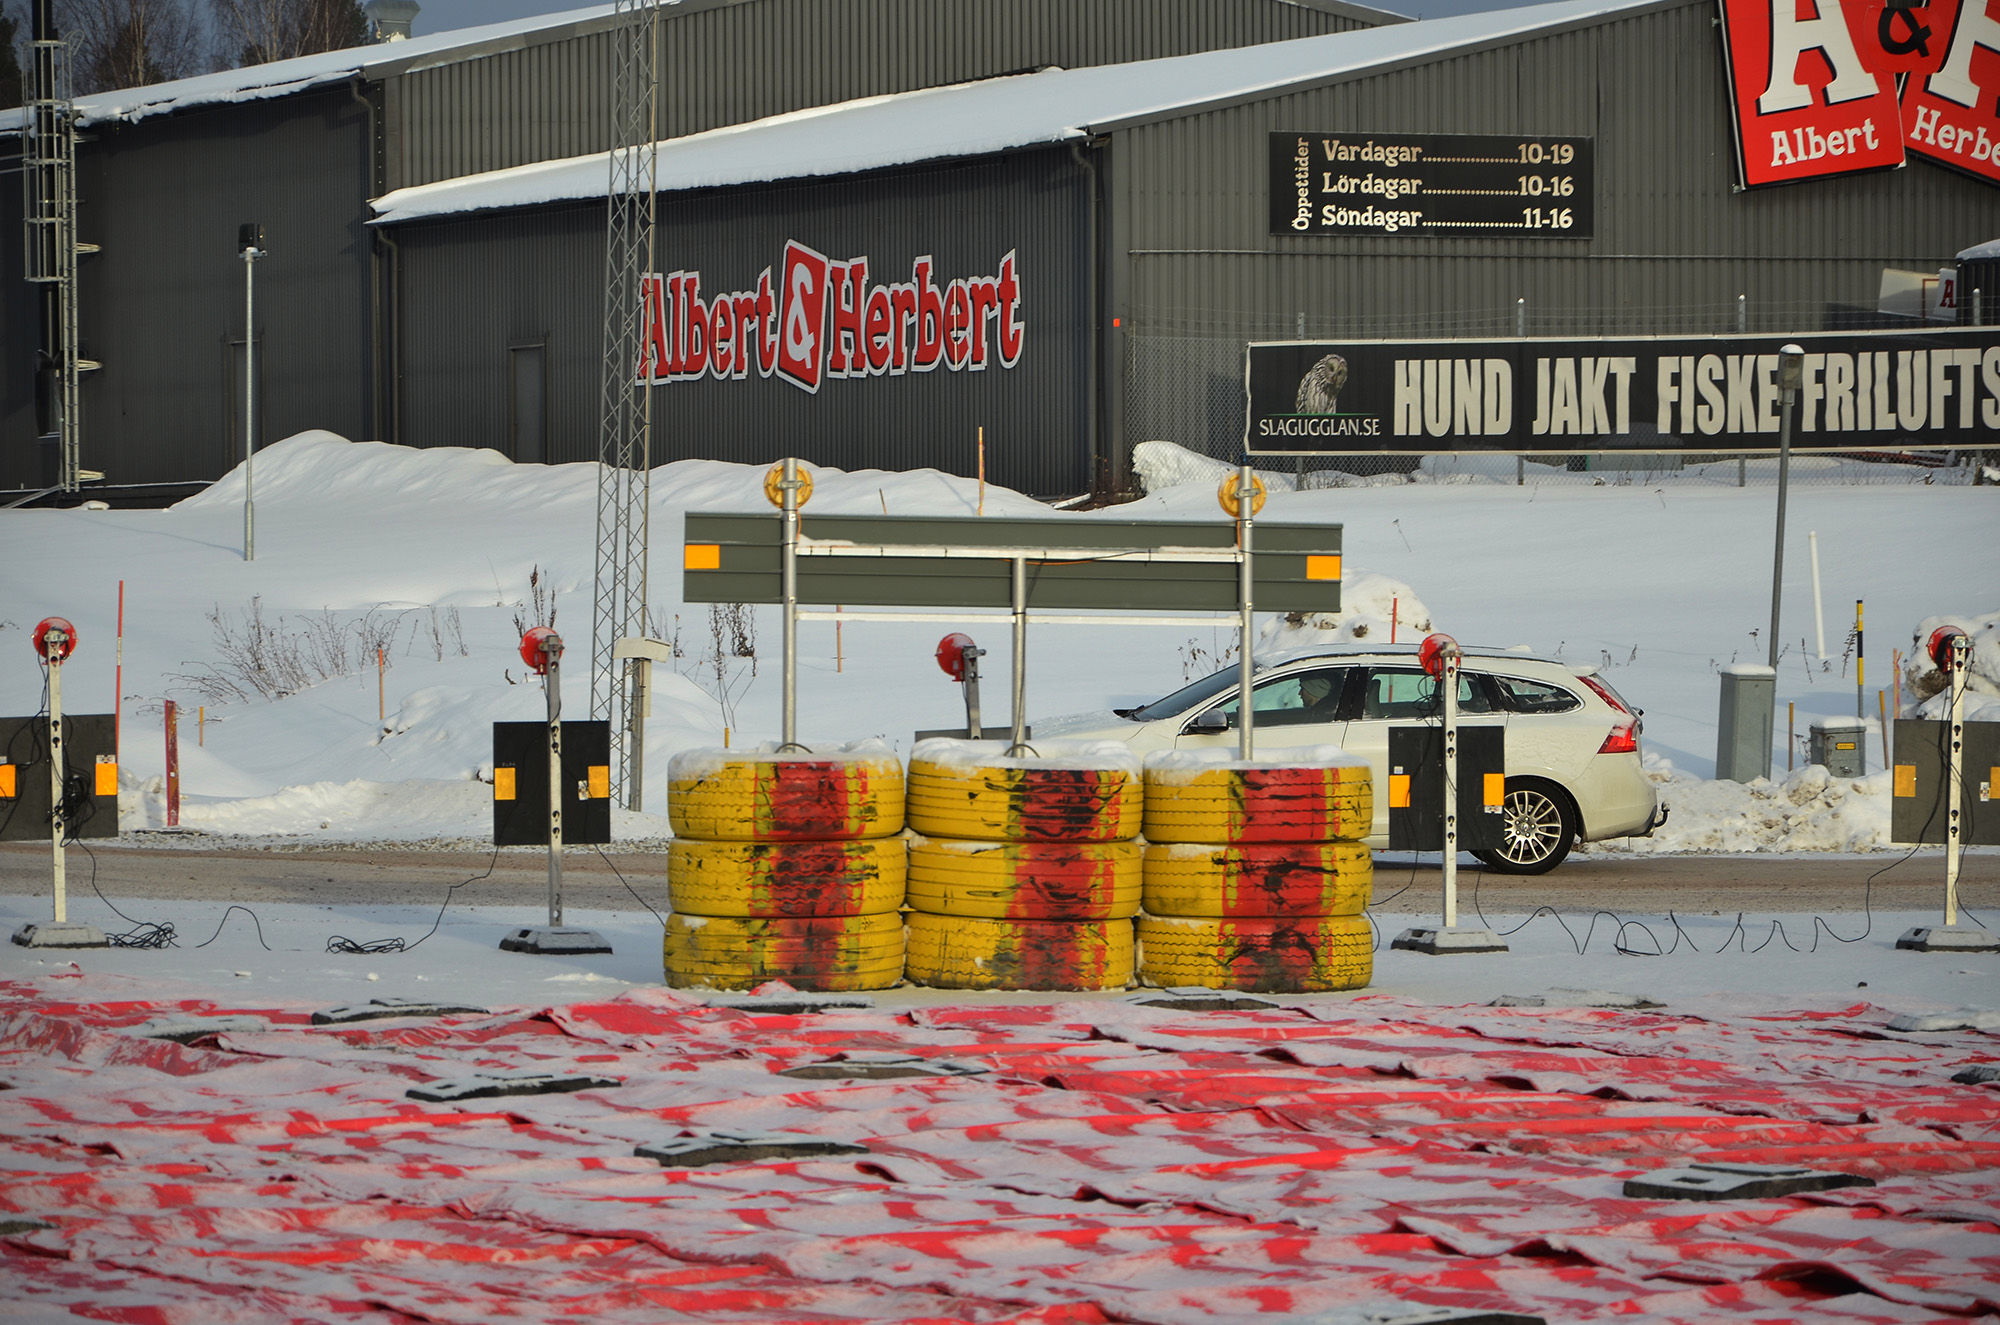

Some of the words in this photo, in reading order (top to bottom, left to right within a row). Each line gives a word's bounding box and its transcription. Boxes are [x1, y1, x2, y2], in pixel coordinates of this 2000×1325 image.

[1757, 0, 1880, 116] A
[1291, 137, 1311, 230] Öppettider
[1770, 118, 1879, 167] Albert
[635, 265, 777, 386] Albert
[828, 249, 1024, 379] Herbert
[1259, 418, 1381, 436] SLAGUGGLAN.SE
[1394, 358, 1512, 437] HUND
[1532, 356, 1636, 435] JAKT
[1657, 353, 1781, 435] FISKE
